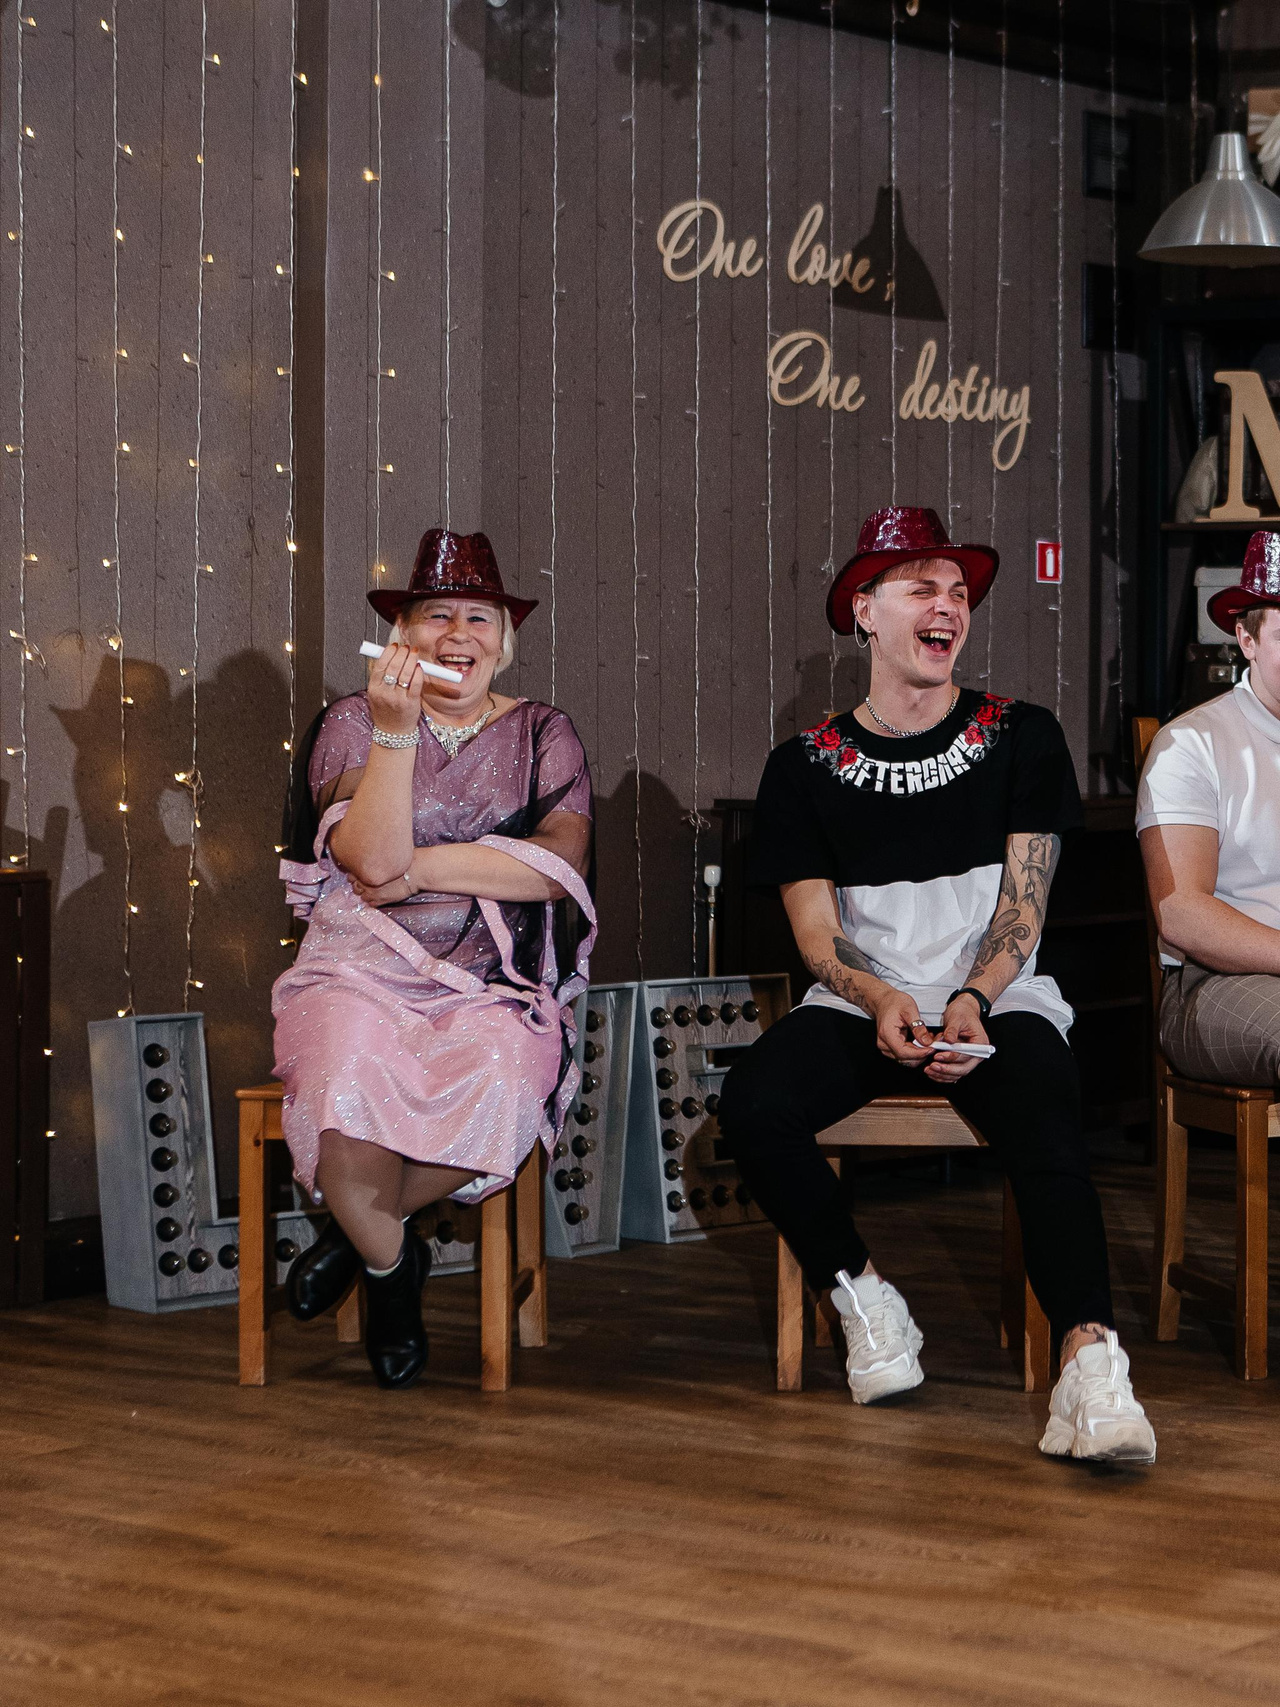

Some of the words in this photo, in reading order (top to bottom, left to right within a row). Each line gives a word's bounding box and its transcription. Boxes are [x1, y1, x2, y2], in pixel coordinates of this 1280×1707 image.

[656, 199, 763, 282] One
[767, 331, 865, 412] One
[899, 340, 1031, 471] destiny
